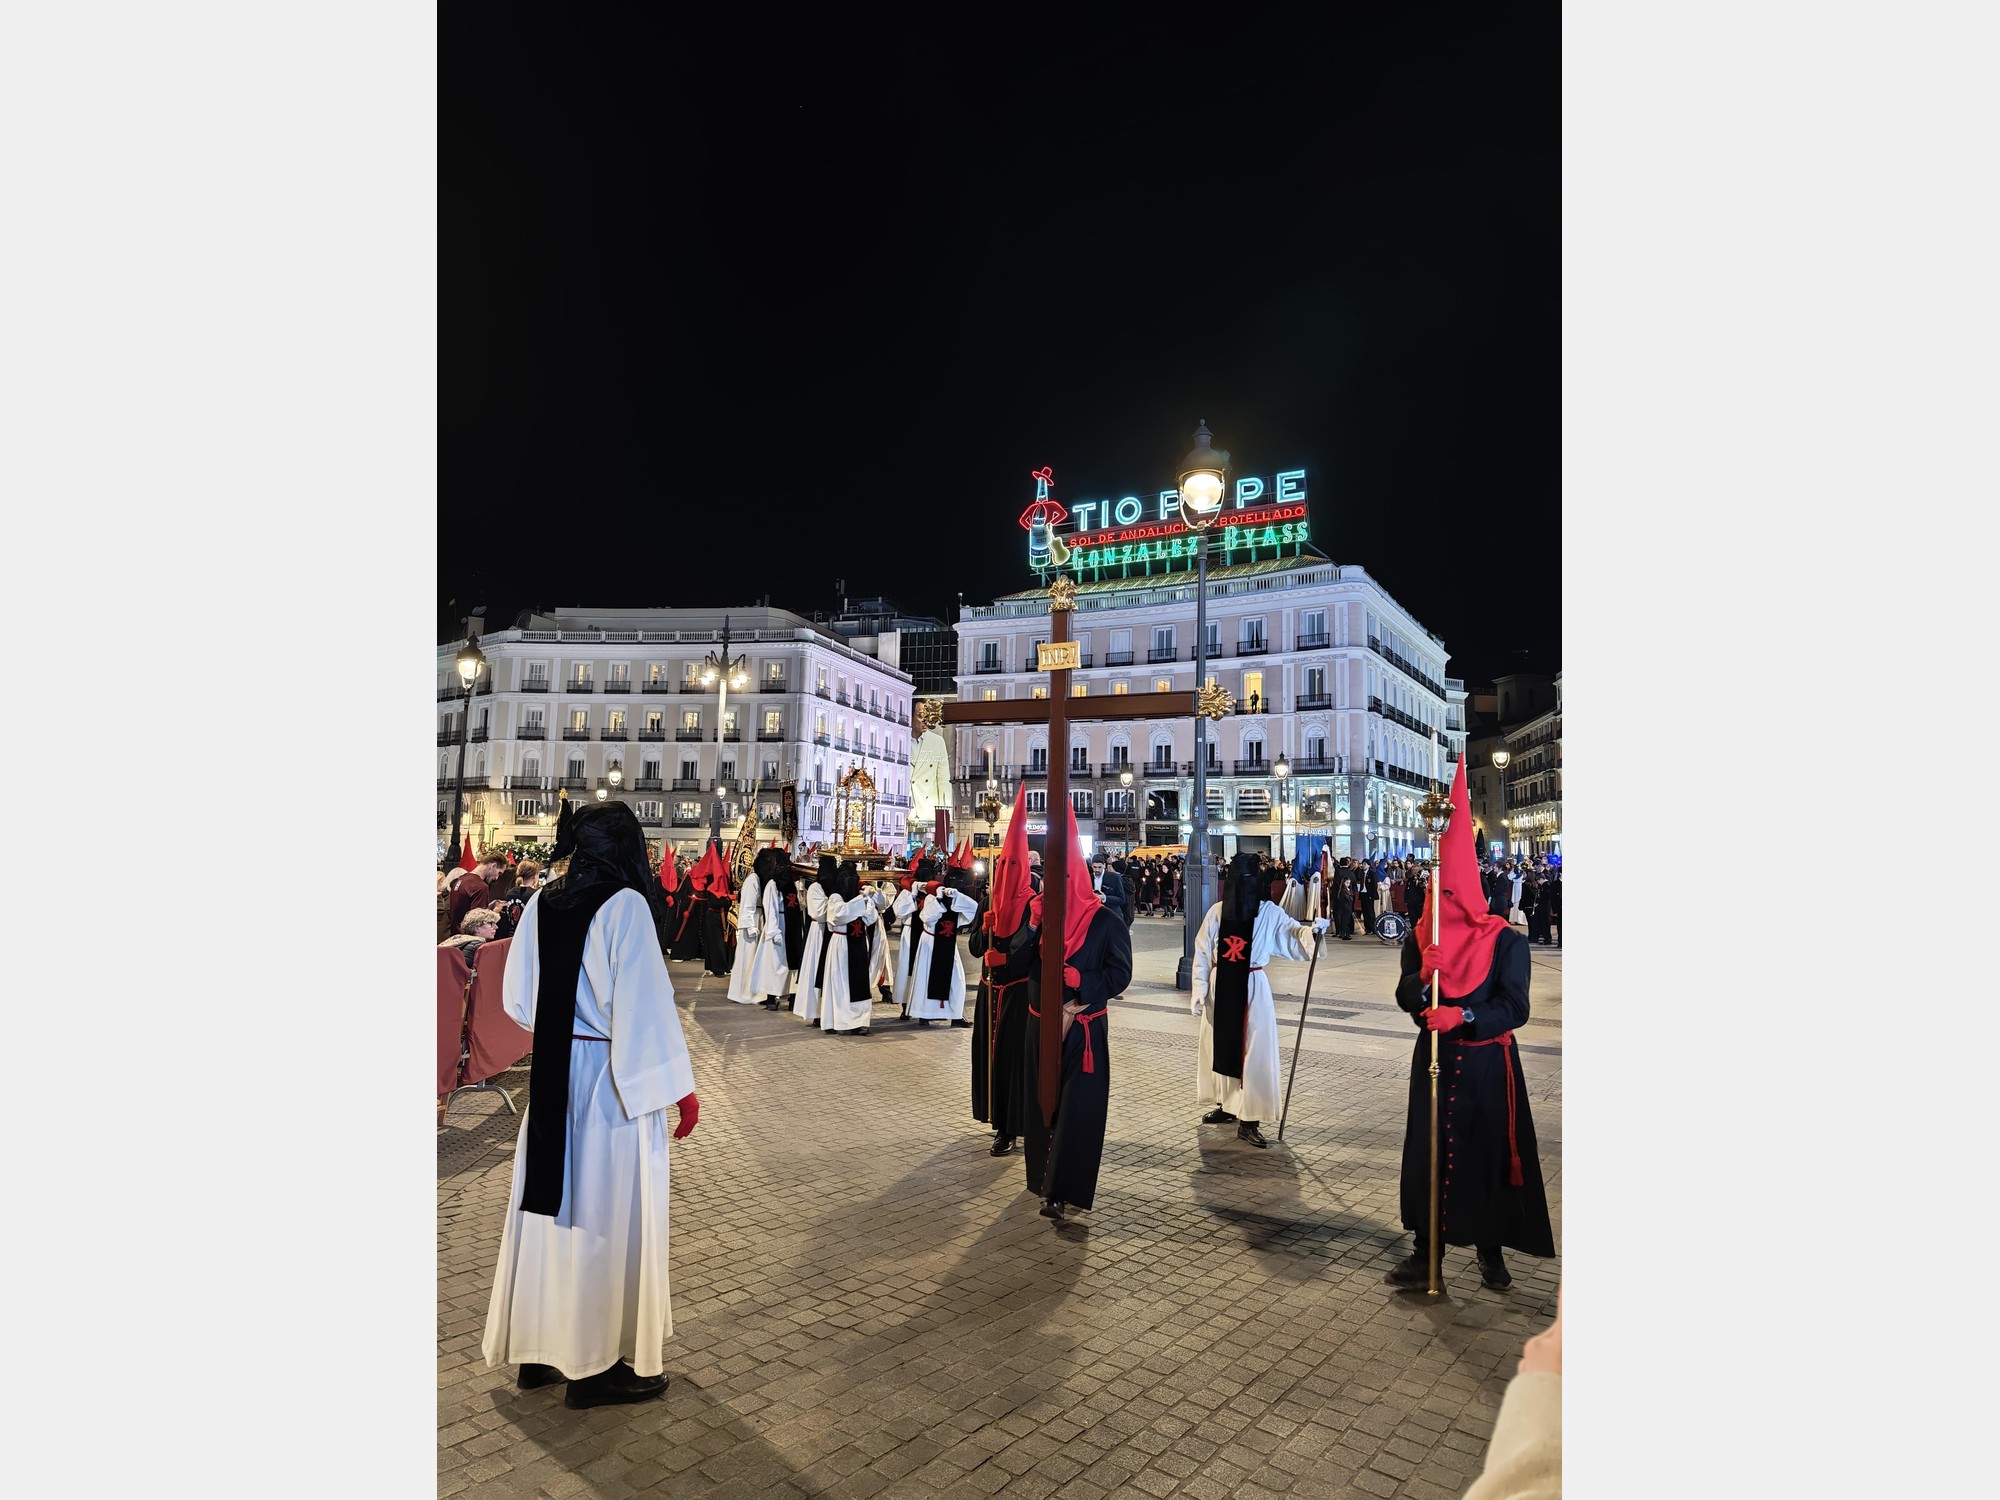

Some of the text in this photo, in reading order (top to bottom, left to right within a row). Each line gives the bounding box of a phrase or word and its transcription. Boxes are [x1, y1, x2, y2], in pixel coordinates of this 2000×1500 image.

[1072, 469, 1305, 532] TIO PPE
[1069, 536, 1096, 548] SOL
[1098, 532, 1116, 543] DE
[1072, 536, 1198, 569] GONZALEZ
[1224, 521, 1308, 551] BYASS
[1041, 646, 1076, 667] INRI
